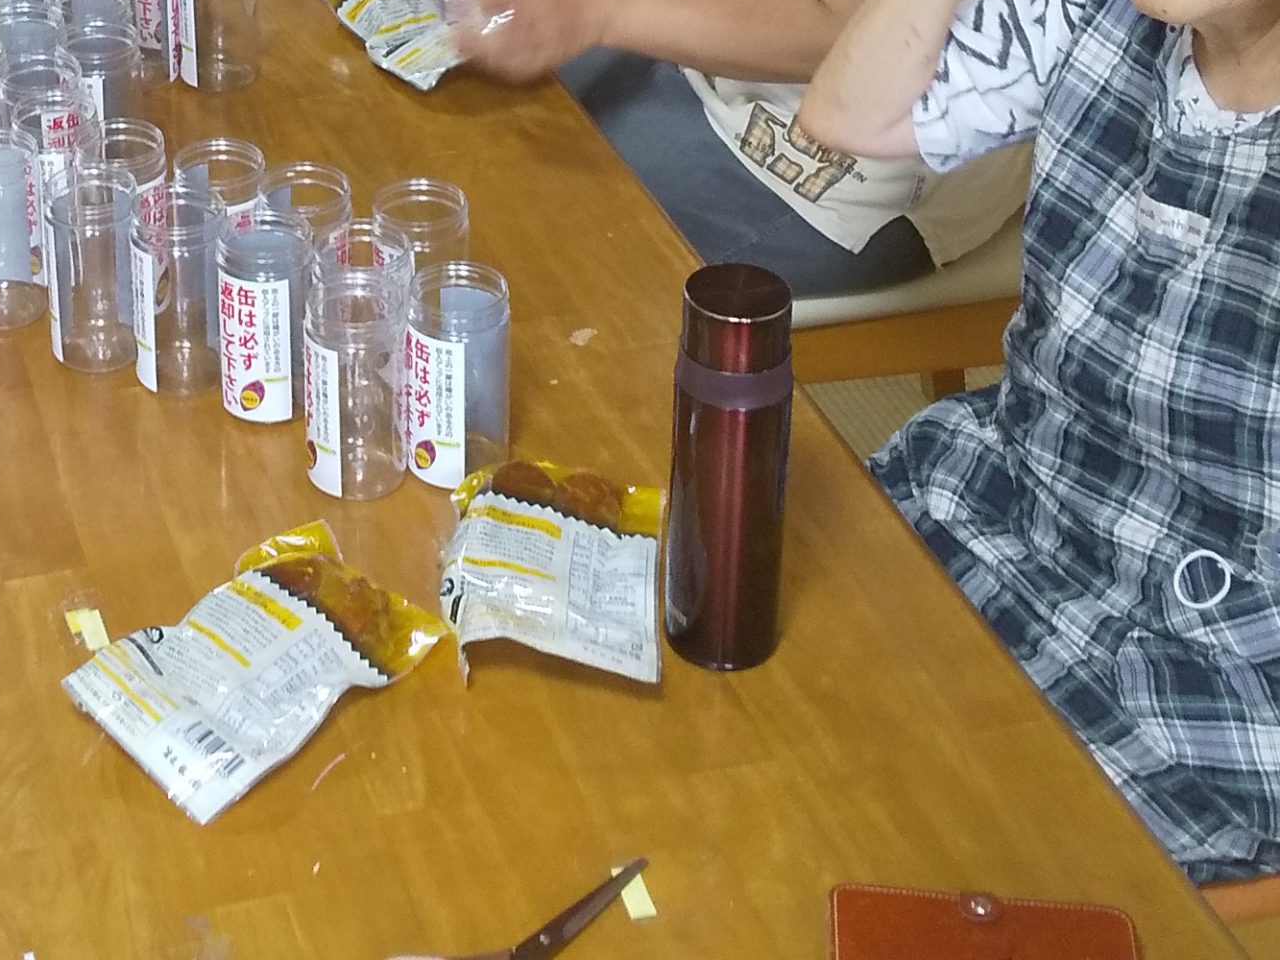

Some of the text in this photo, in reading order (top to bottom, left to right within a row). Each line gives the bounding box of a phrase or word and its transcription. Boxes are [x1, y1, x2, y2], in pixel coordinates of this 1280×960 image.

[221, 281, 238, 407] 返却して下さい
[237, 286, 258, 371] 缶は必ず
[415, 338, 431, 428] 缶は必ず
